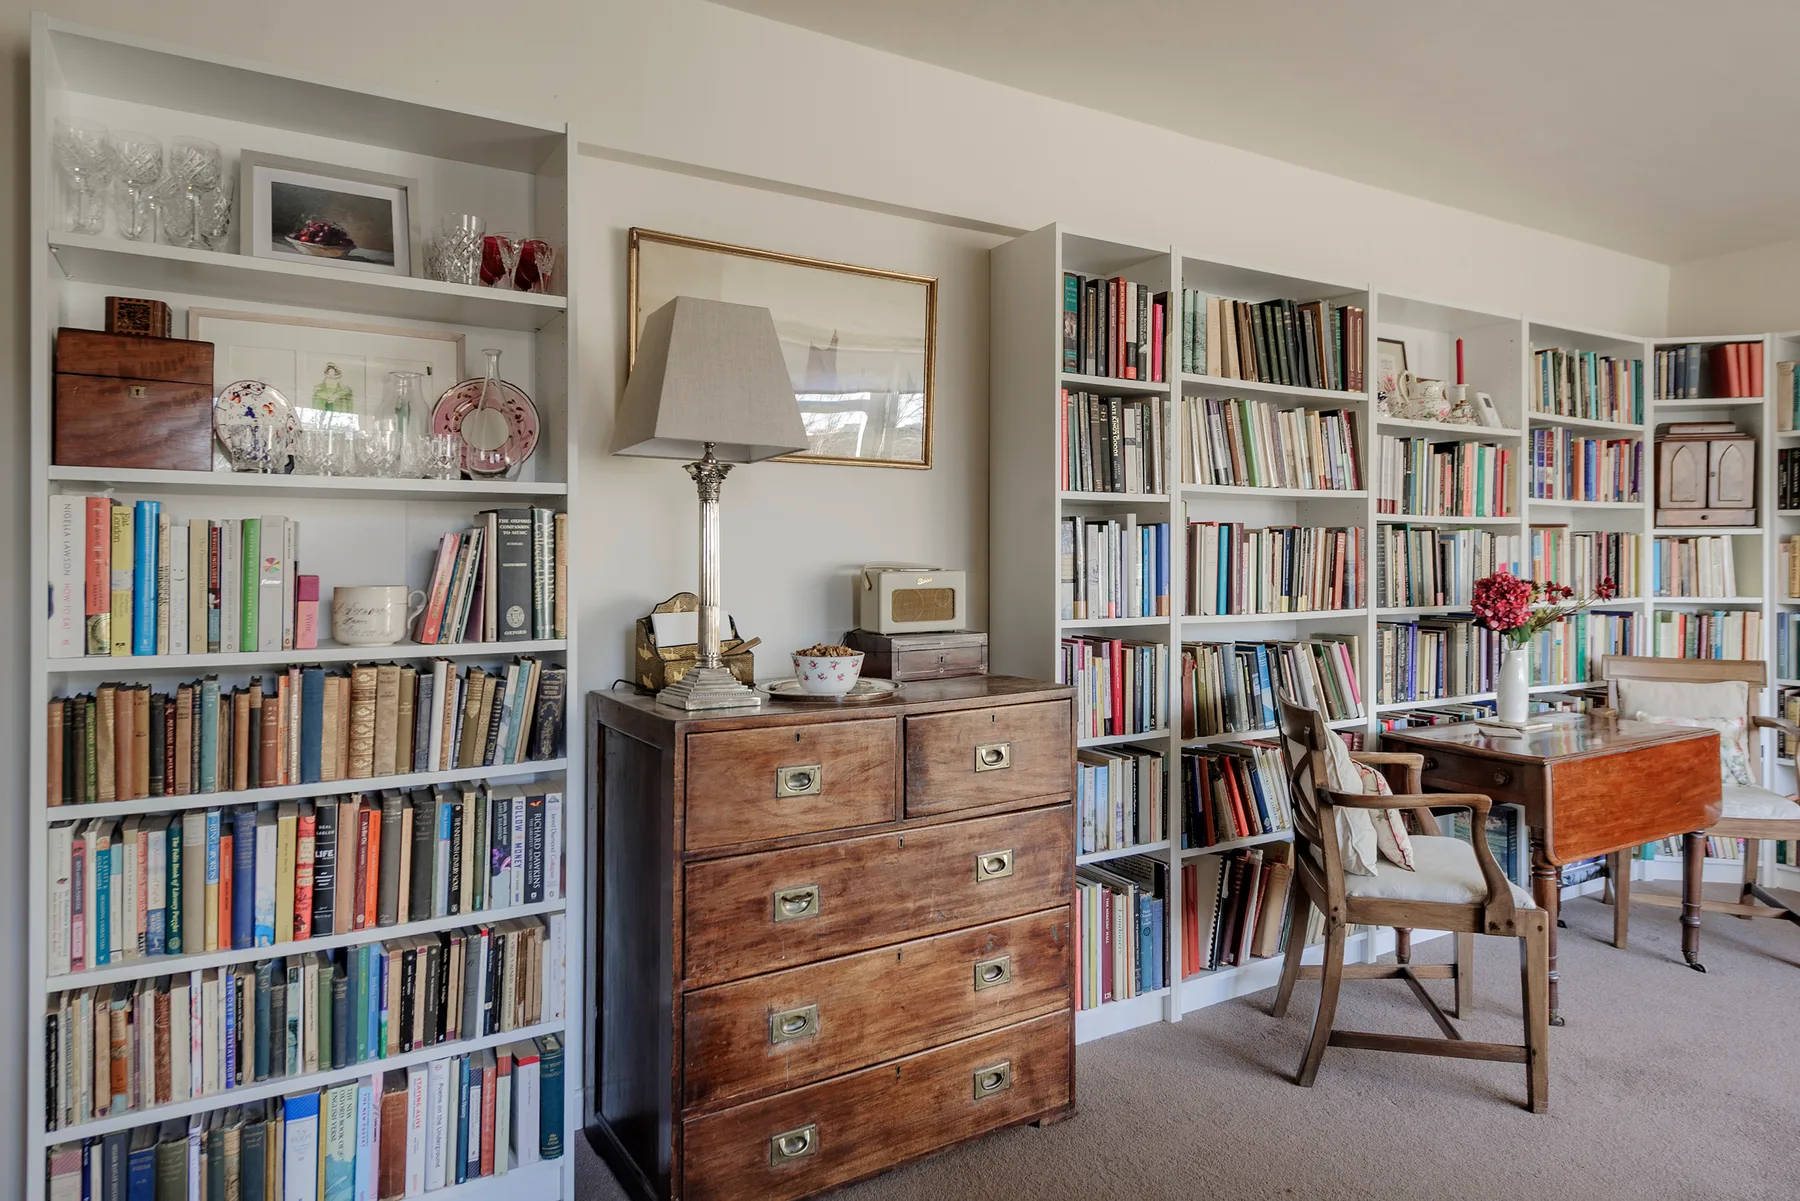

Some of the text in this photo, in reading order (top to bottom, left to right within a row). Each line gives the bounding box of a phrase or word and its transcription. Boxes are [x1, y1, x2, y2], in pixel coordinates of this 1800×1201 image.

[113, 512, 122, 542] London
[122, 512, 131, 526] Eat
[63, 503, 72, 576] NIGELLA LAWSON
[534, 522, 544, 610] Collected Poems
[64, 583, 72, 630] HOW TO EAT
[305, 613, 314, 633] Wine
[514, 800, 524, 832] FOLLOW
[170, 836, 180, 847] The
[533, 813, 542, 888] RICHARD DAWKINS
[315, 850, 334, 858] LIFE
[514, 842, 524, 868] MONEY
[170, 864, 180, 878] Book
[528, 862, 533, 870] ON
[170, 879, 180, 887] of
[226, 980, 234, 995] BEN
[226, 1028, 234, 1082] MENTAL FIGHT
[435, 1083, 444, 1104] Poems
[435, 1115, 444, 1124] the
[339, 1140, 344, 1150] OF
[435, 1128, 444, 1168] Underground
